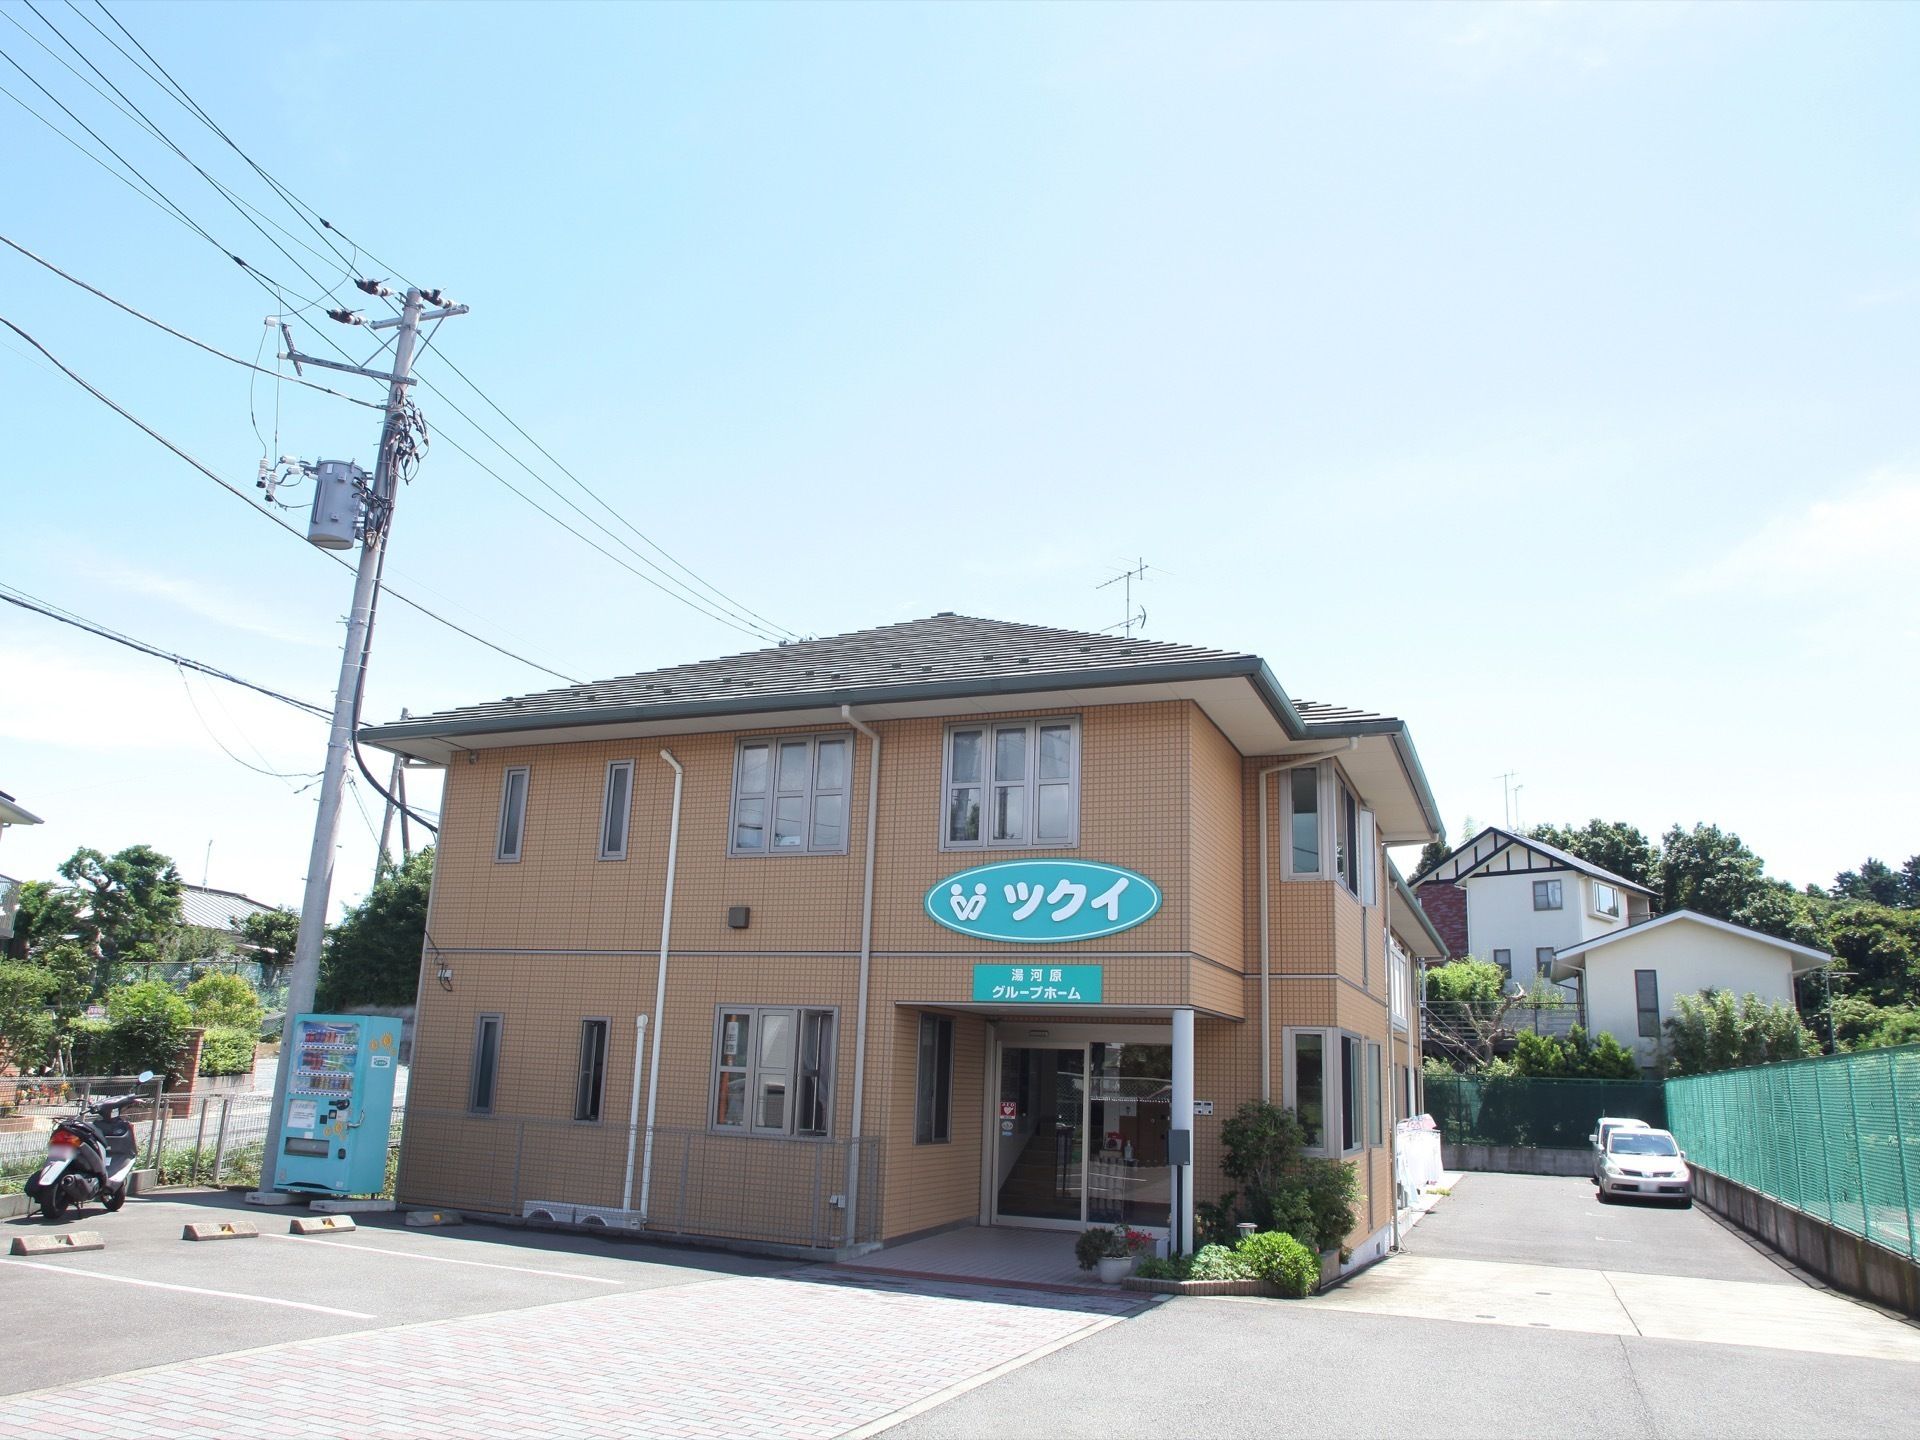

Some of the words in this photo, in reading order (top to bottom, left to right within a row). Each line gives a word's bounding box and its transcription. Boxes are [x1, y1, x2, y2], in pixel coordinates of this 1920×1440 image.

[1003, 877, 1130, 922] ツクイ
[1011, 968, 1062, 982] 湯河原
[992, 985, 1081, 1000] グループホーム
